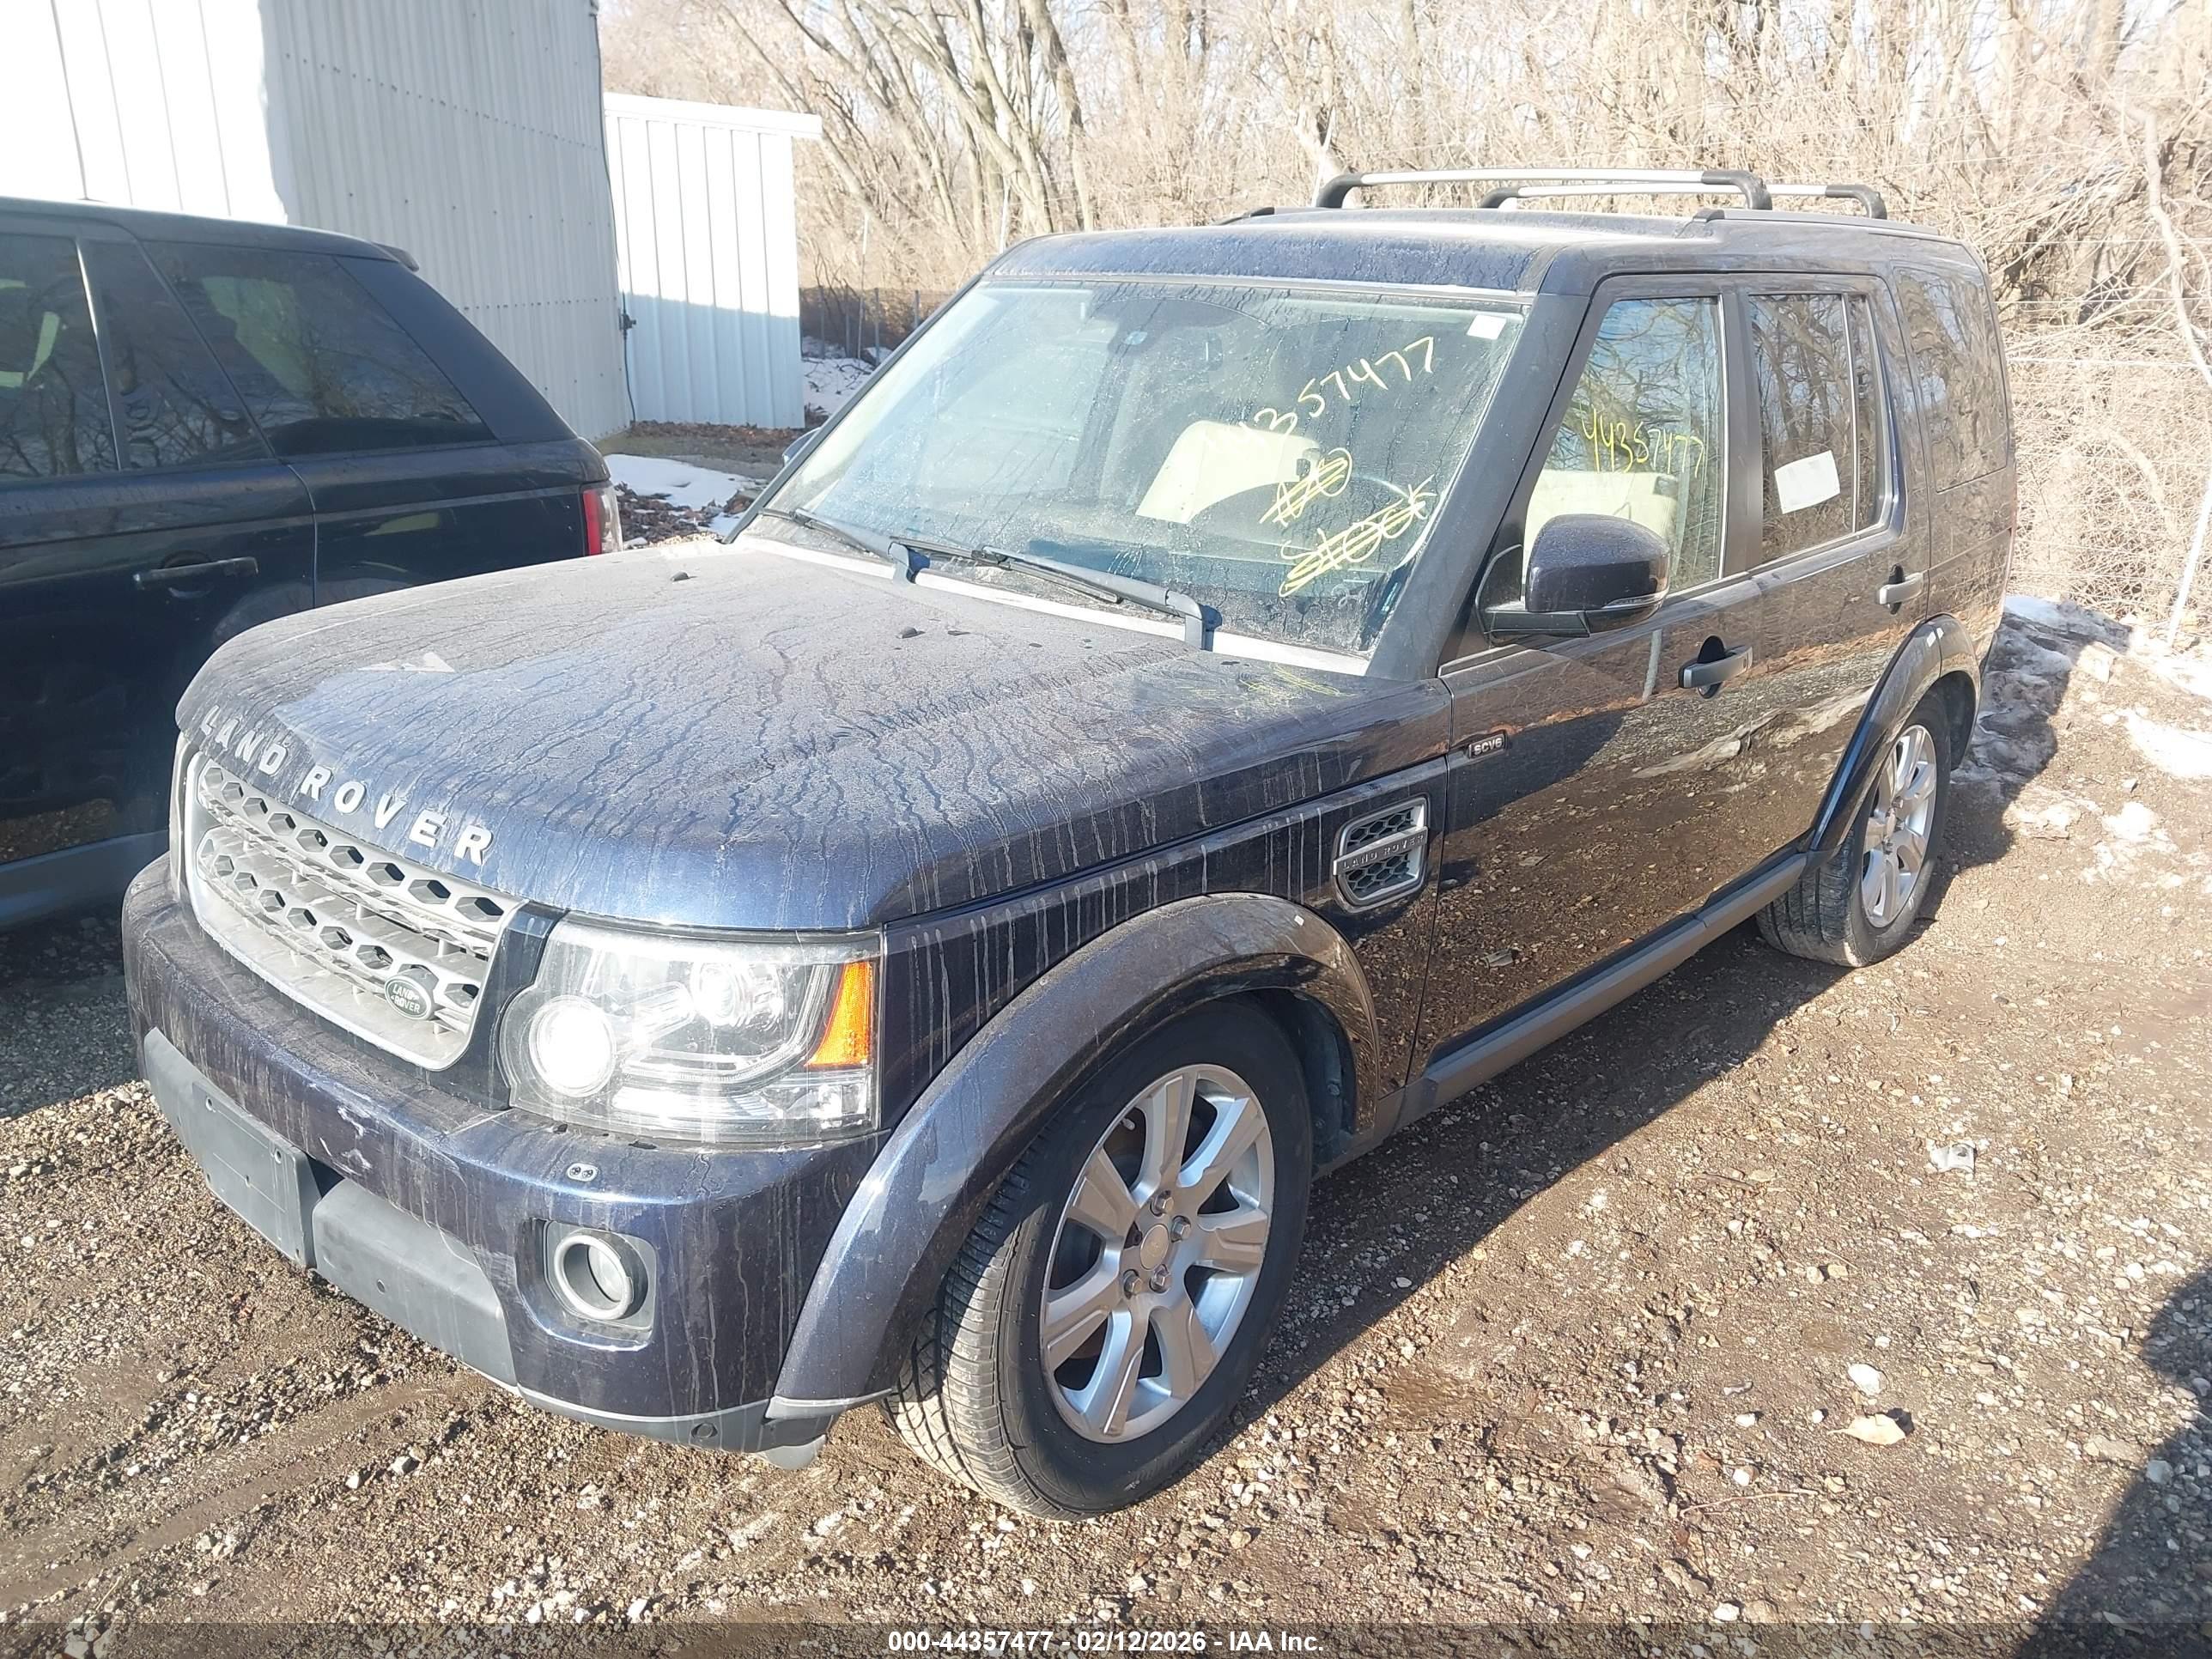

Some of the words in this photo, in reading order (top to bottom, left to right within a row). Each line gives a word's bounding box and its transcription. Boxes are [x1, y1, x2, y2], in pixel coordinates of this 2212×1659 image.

[1202, 336, 1434, 450] 357477
[1579, 404, 1705, 478] 44357477
[1473, 737, 1504, 756] SCV6
[200, 705, 289, 776] LAND
[301, 765, 494, 866] ROVER
[1343, 851, 1378, 871] LAND
[1384, 835, 1425, 855] ROVER
[392, 983, 415, 1000] LAND
[394, 996, 421, 1013] ROVER
